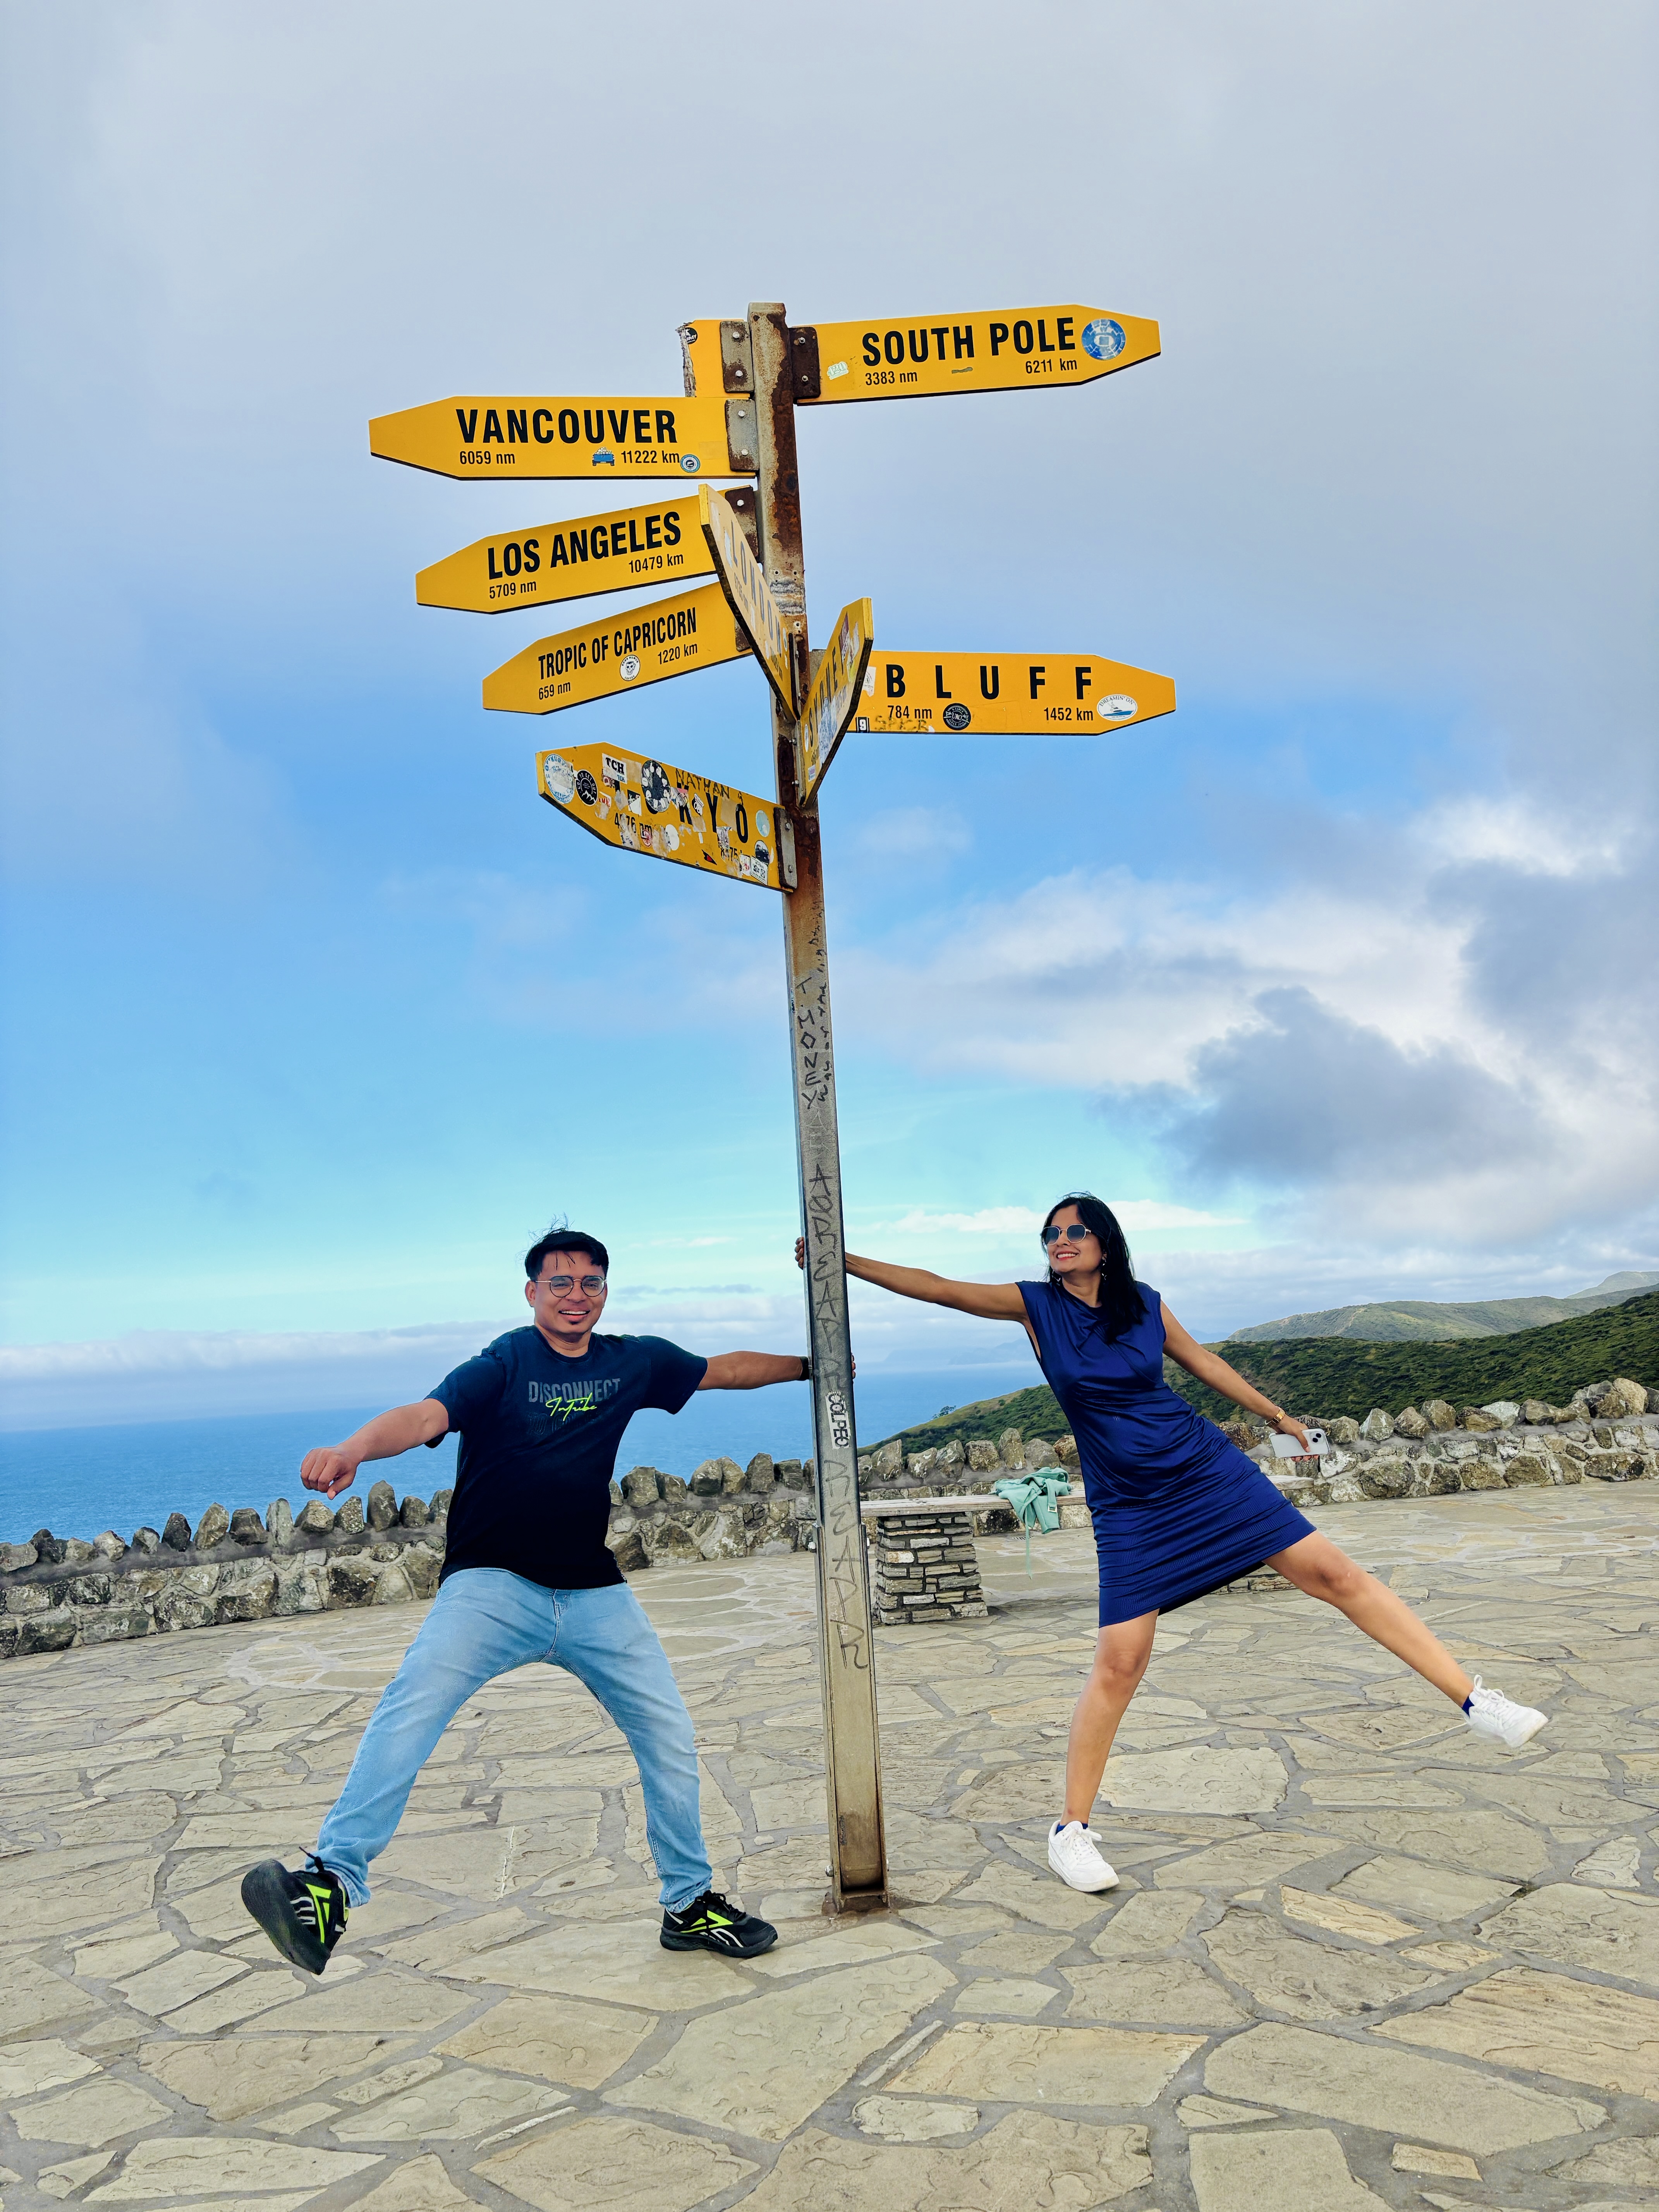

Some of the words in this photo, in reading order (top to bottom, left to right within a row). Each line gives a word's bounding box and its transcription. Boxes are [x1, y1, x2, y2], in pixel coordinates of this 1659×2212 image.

[862, 325, 974, 366] SOUTH
[989, 317, 1076, 356] POLE
[1025, 359, 1052, 374] 6211
[1060, 358, 1077, 371] km
[865, 371, 895, 386] 3383
[900, 372, 917, 383] nm
[455, 409, 677, 444] VANCOUVER
[460, 451, 491, 464] 6059
[496, 453, 515, 464] nm
[621, 450, 658, 463] 11222
[662, 450, 680, 463] km
[488, 539, 540, 580] LOS
[550, 511, 681, 568] ANGELES
[629, 555, 663, 573] 10479
[667, 553, 684, 567] km
[489, 582, 516, 599] 5709
[520, 581, 536, 593] nm
[731, 520, 781, 658] LONDON
[538, 642, 587, 680] TROPIC
[592, 635, 608, 664] OF
[614, 607, 696, 657] CAPRICORN
[658, 646, 680, 665] 1220
[684, 644, 697, 657] km
[539, 684, 554, 700] 659
[558, 682, 570, 694] nm
[886, 664, 1091, 700] BLUFF
[888, 705, 910, 718] 784
[914, 709, 932, 719] nm
[1044, 707, 1072, 721] 1452
[1076, 708, 1093, 721] km
[859, 719, 866, 731] 9
[676, 768, 730, 799] NATHAN
[615, 812, 636, 833] 476
[528, 1378, 621, 1403] DISCONNECT
